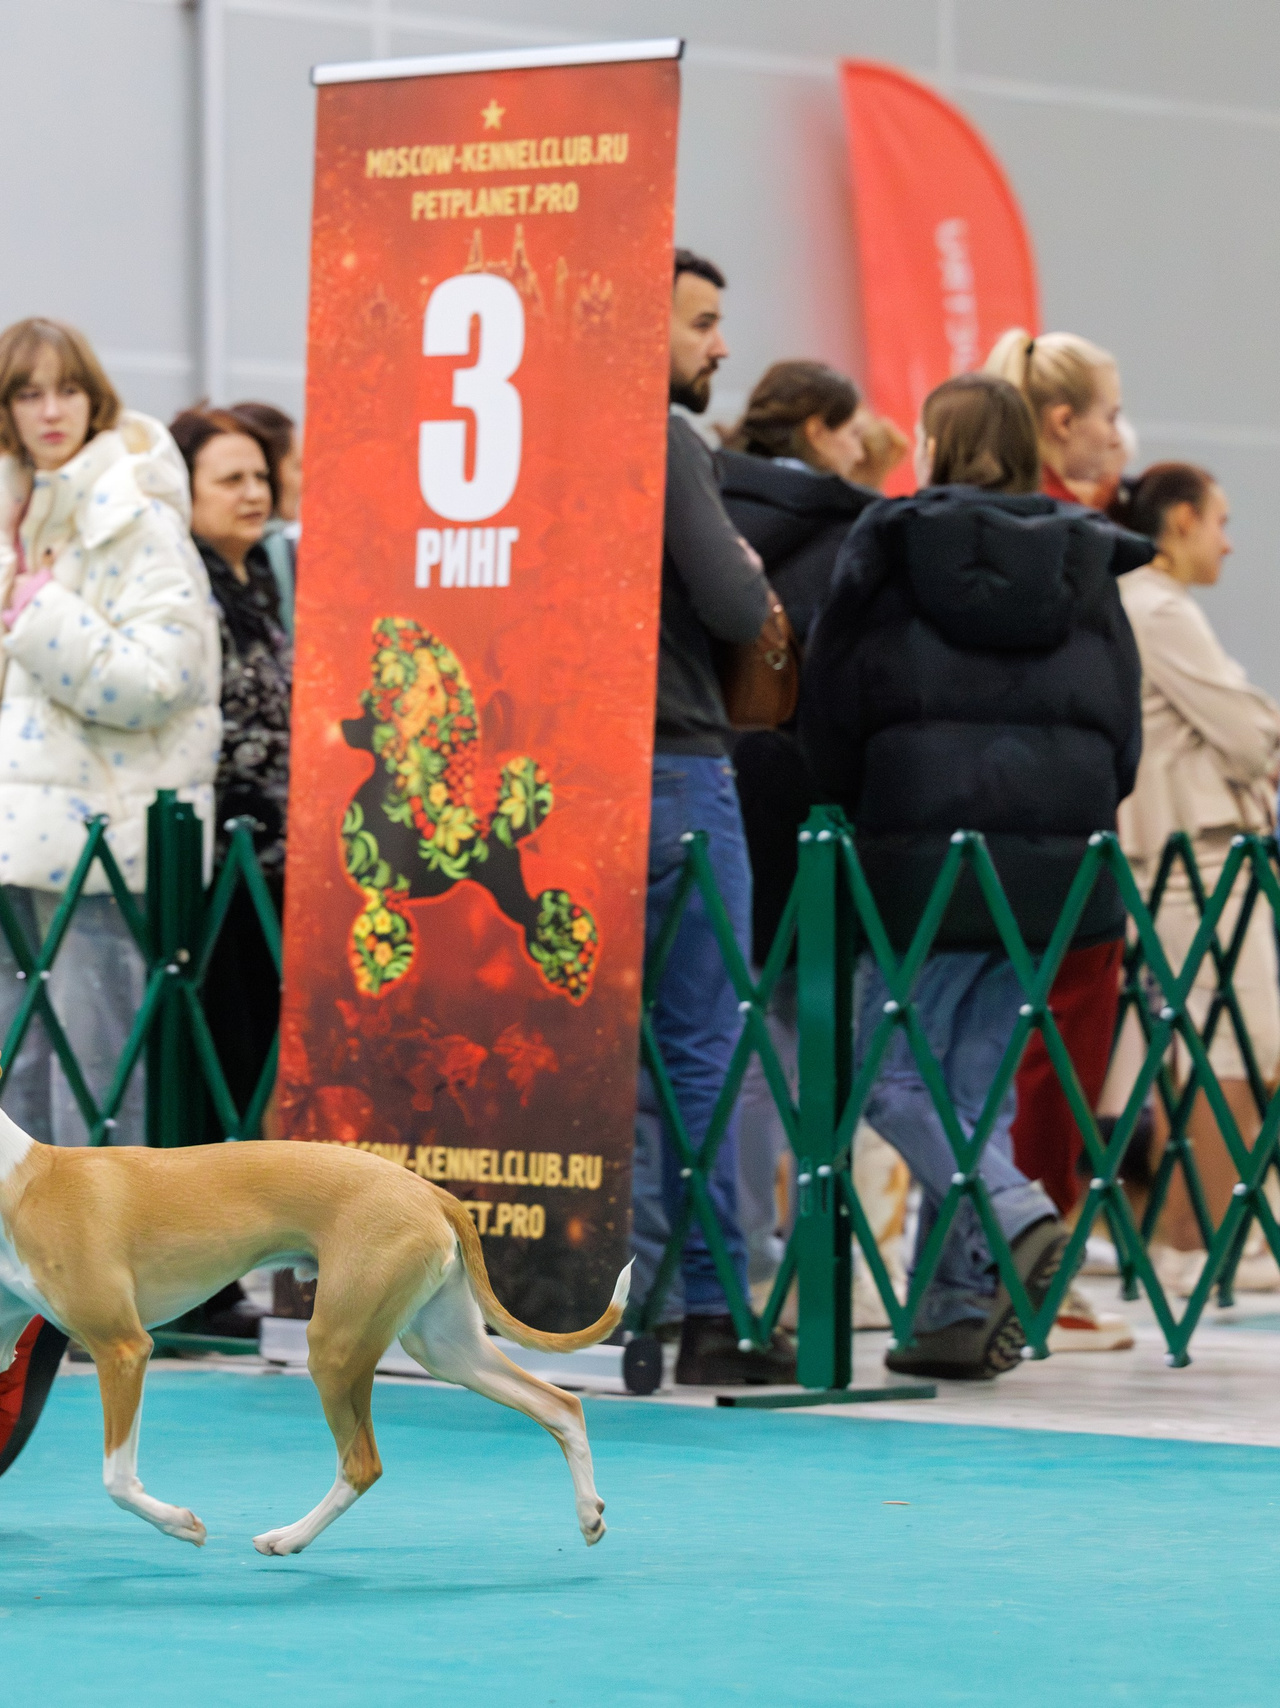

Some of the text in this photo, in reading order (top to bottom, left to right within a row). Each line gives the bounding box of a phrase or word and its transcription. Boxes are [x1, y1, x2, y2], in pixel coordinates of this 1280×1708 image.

[365, 133, 629, 179] MOSCOW-KENNELCLUB.RU
[410, 181, 580, 221] PETPLANET.PRO
[419, 273, 526, 523] 3
[415, 526, 520, 589] РИНГ
